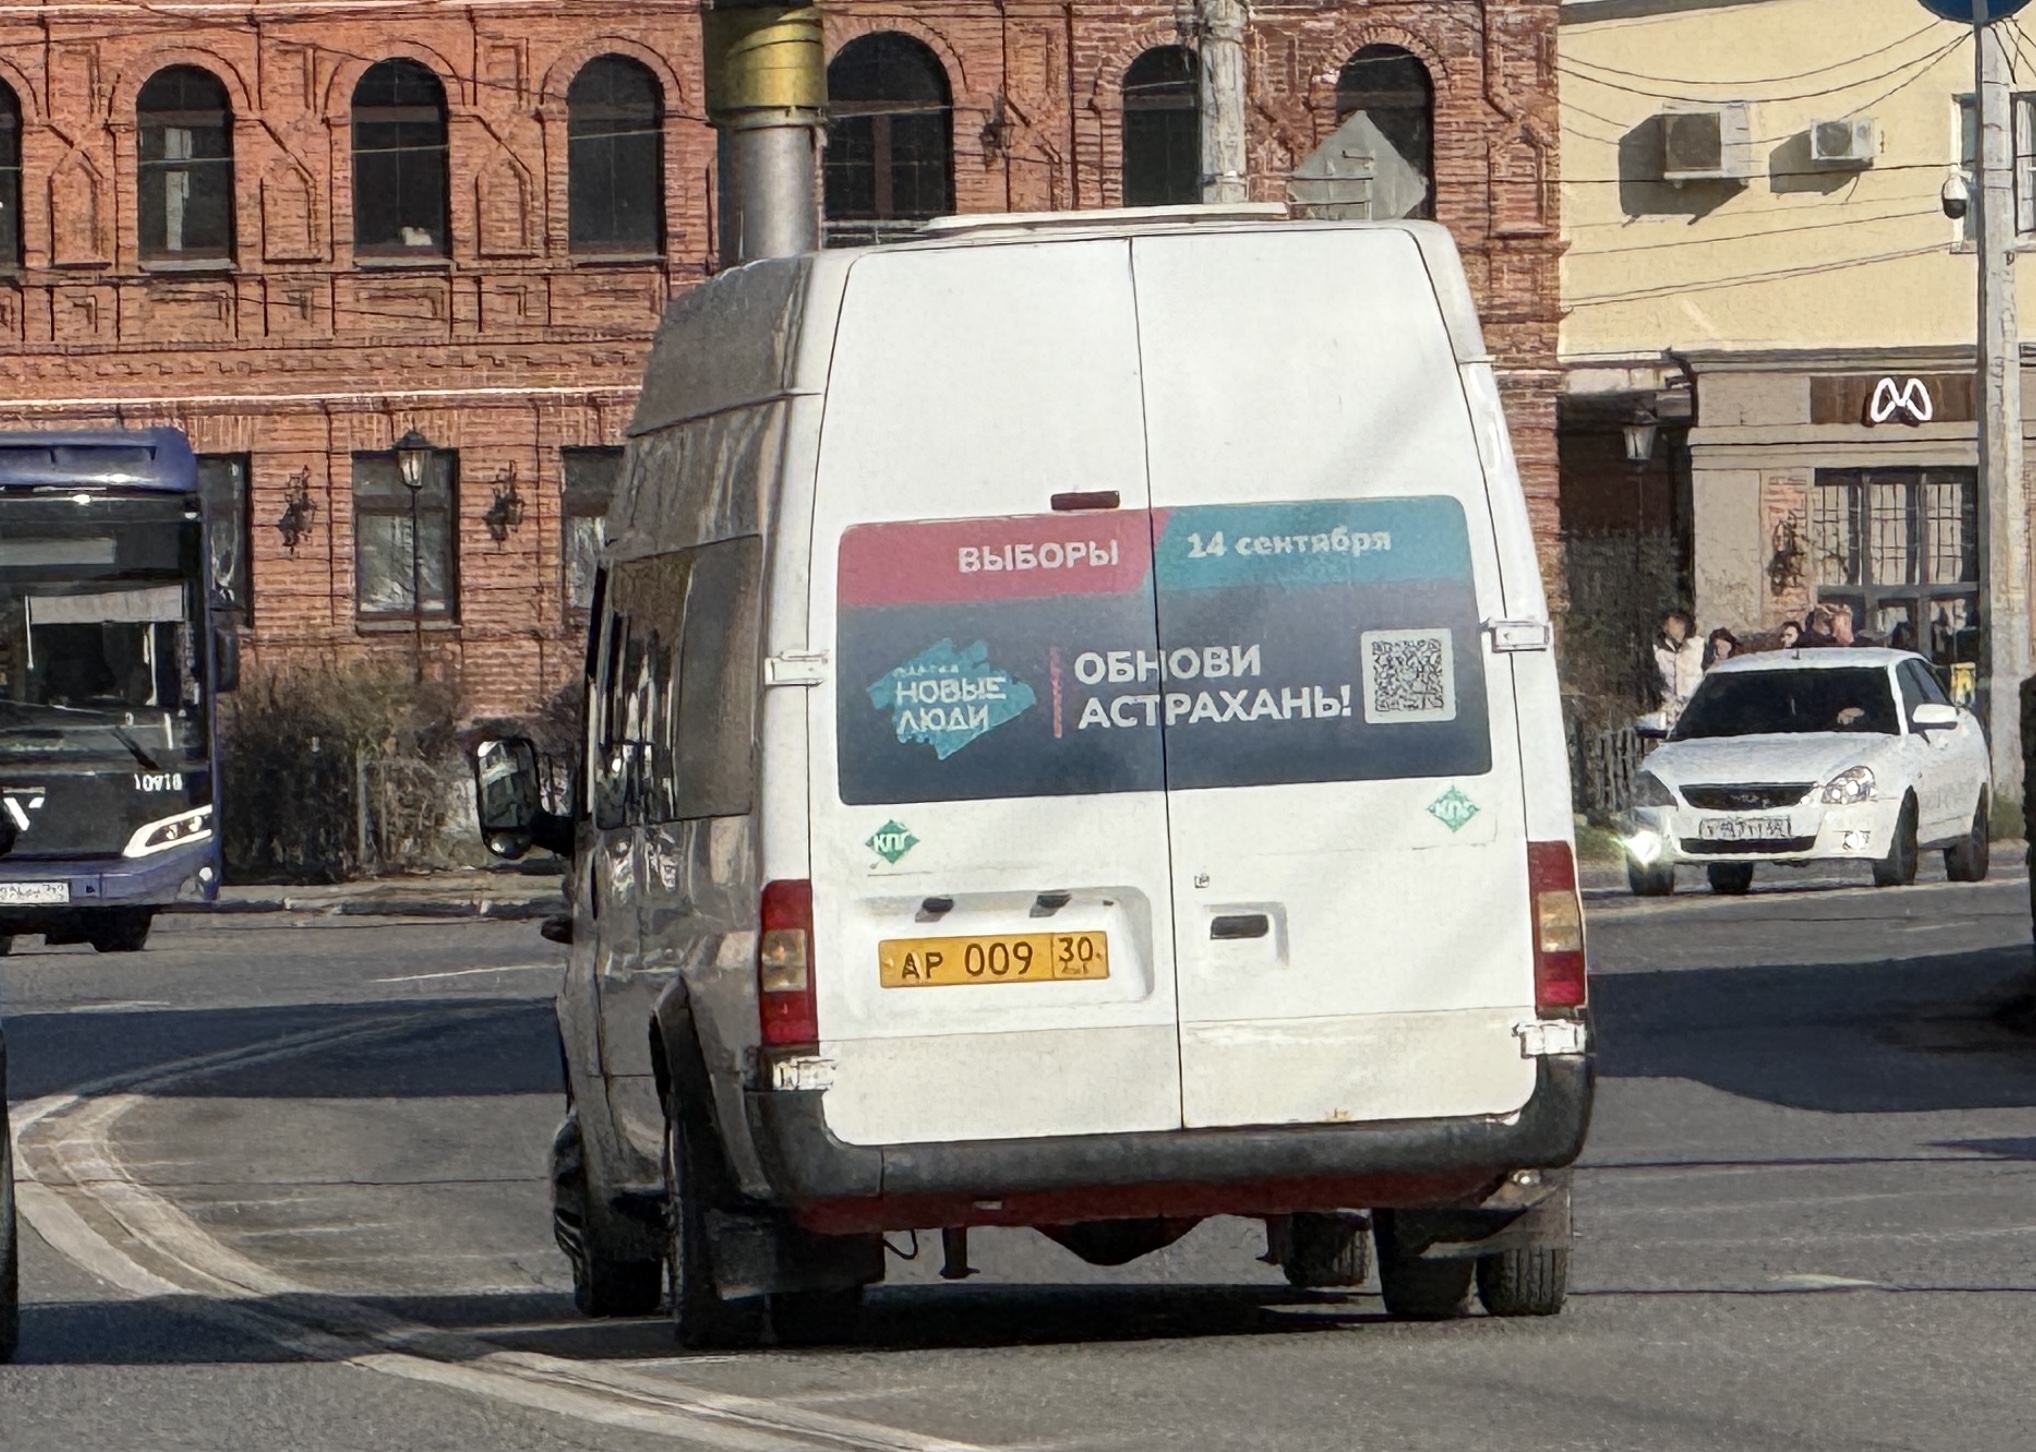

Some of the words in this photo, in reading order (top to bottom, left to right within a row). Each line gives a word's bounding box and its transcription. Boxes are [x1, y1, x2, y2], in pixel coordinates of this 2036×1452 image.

[957, 538, 1120, 574] ВЫБОРЫ
[1186, 530, 1227, 559] 14
[1234, 524, 1393, 558] сентября
[1073, 643, 1262, 686] ОБНОВИ
[895, 676, 1007, 706] НОВЫЕ
[1077, 684, 1352, 731] АСТРАХАНЬ!
[895, 703, 990, 736] ЛЮДИ
[901, 951, 944, 980] АР
[963, 940, 1034, 977] 009
[1058, 935, 1094, 962] 30
